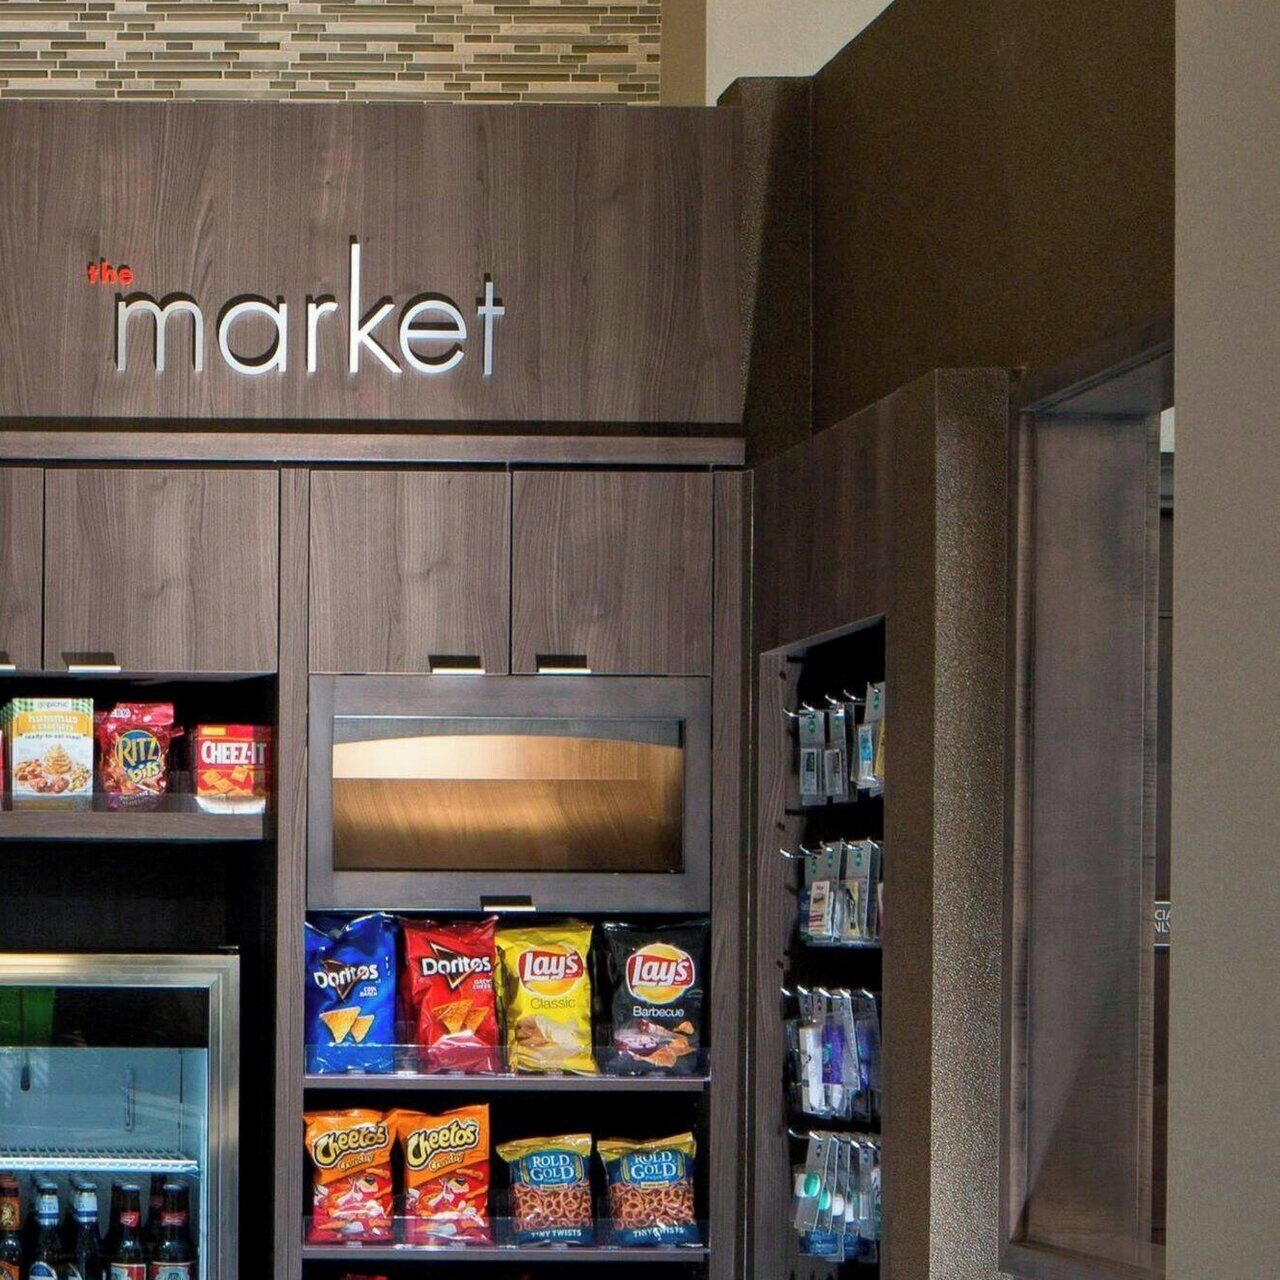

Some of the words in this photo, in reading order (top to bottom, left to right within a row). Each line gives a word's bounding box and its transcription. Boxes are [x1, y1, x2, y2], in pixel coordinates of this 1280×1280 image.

[86, 259, 134, 285] the
[116, 242, 506, 376] market
[117, 736, 159, 767] RITZ
[201, 740, 267, 764] CHEEZ-IT
[126, 763, 160, 782] bits
[314, 963, 379, 988] Doritos
[421, 957, 491, 976] Doritos
[524, 952, 578, 982] Lay's
[632, 956, 690, 986] Lay's
[530, 997, 576, 1009] Classic
[633, 1006, 685, 1017] Barbecue
[315, 1124, 387, 1166] Cheetos
[408, 1121, 477, 1167] Cheetos
[530, 1166, 575, 1180] GOLD
[532, 1154, 570, 1169] ROLD
[631, 1162, 677, 1180] GOLD
[552, 1228, 582, 1238] TWISTS
